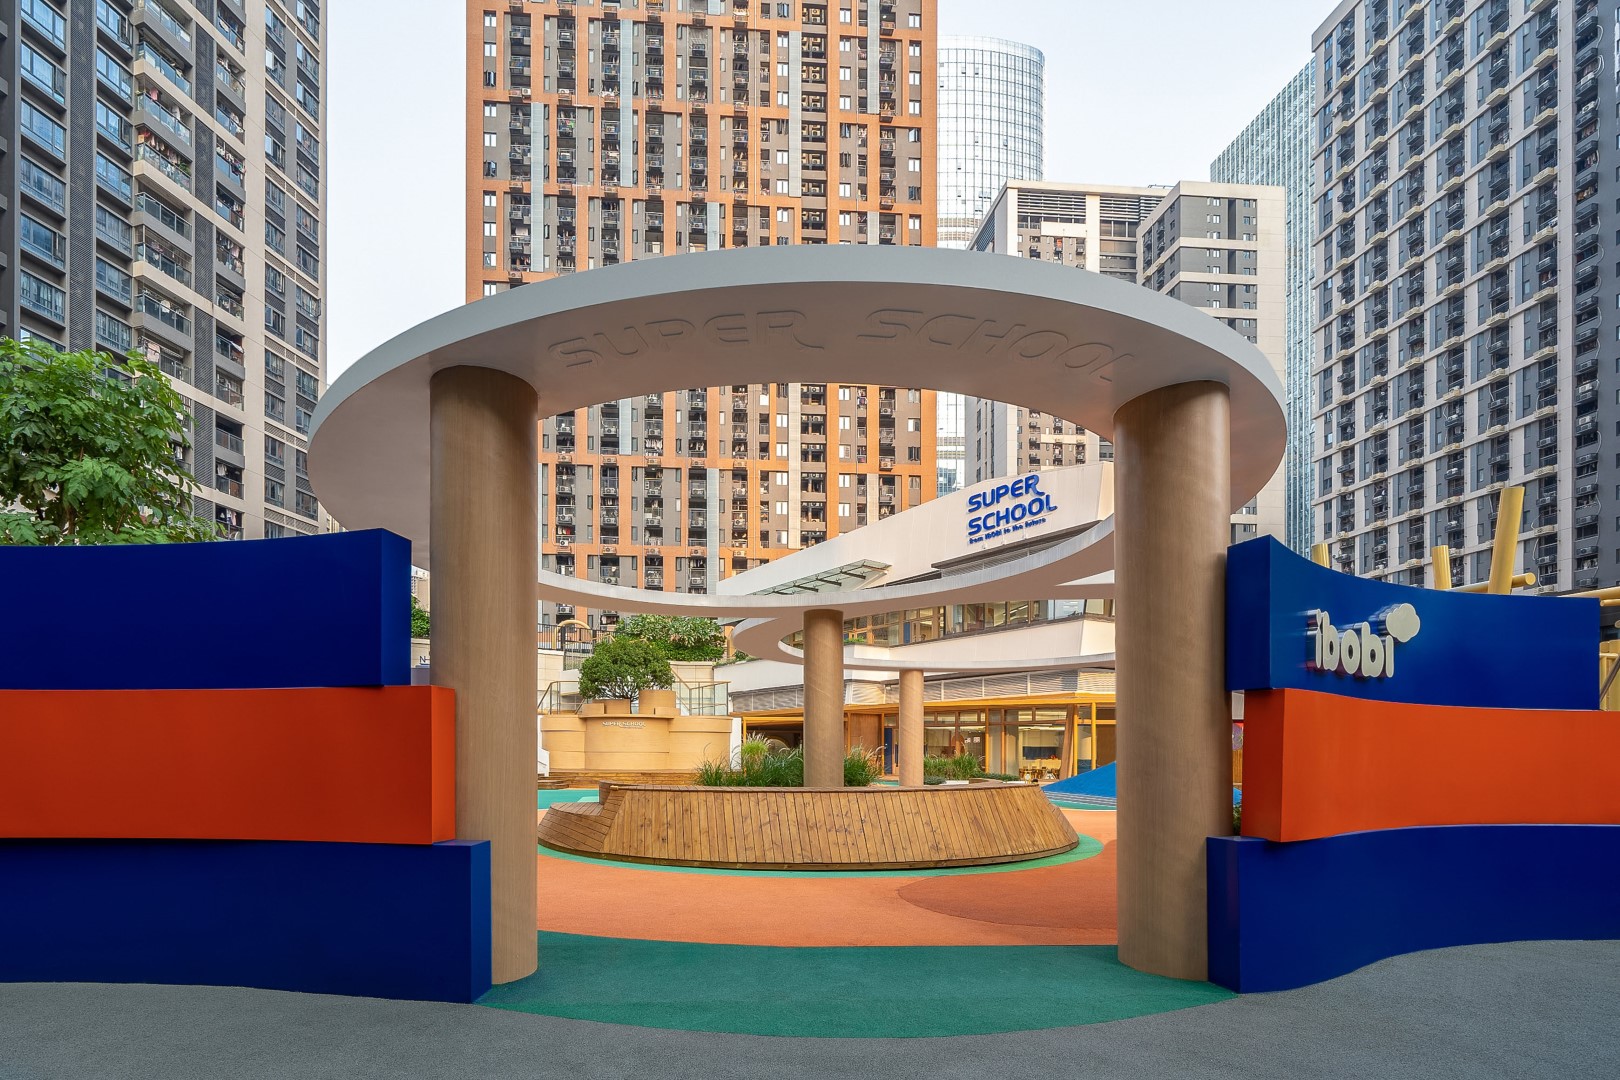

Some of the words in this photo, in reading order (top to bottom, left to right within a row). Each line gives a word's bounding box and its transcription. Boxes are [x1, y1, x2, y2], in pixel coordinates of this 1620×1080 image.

[547, 309, 825, 368] SUPER
[856, 308, 1136, 383] SCHOOL
[968, 474, 1045, 513] SUPER
[968, 494, 1058, 536] SCHOOL
[1315, 608, 1395, 678] ibobi
